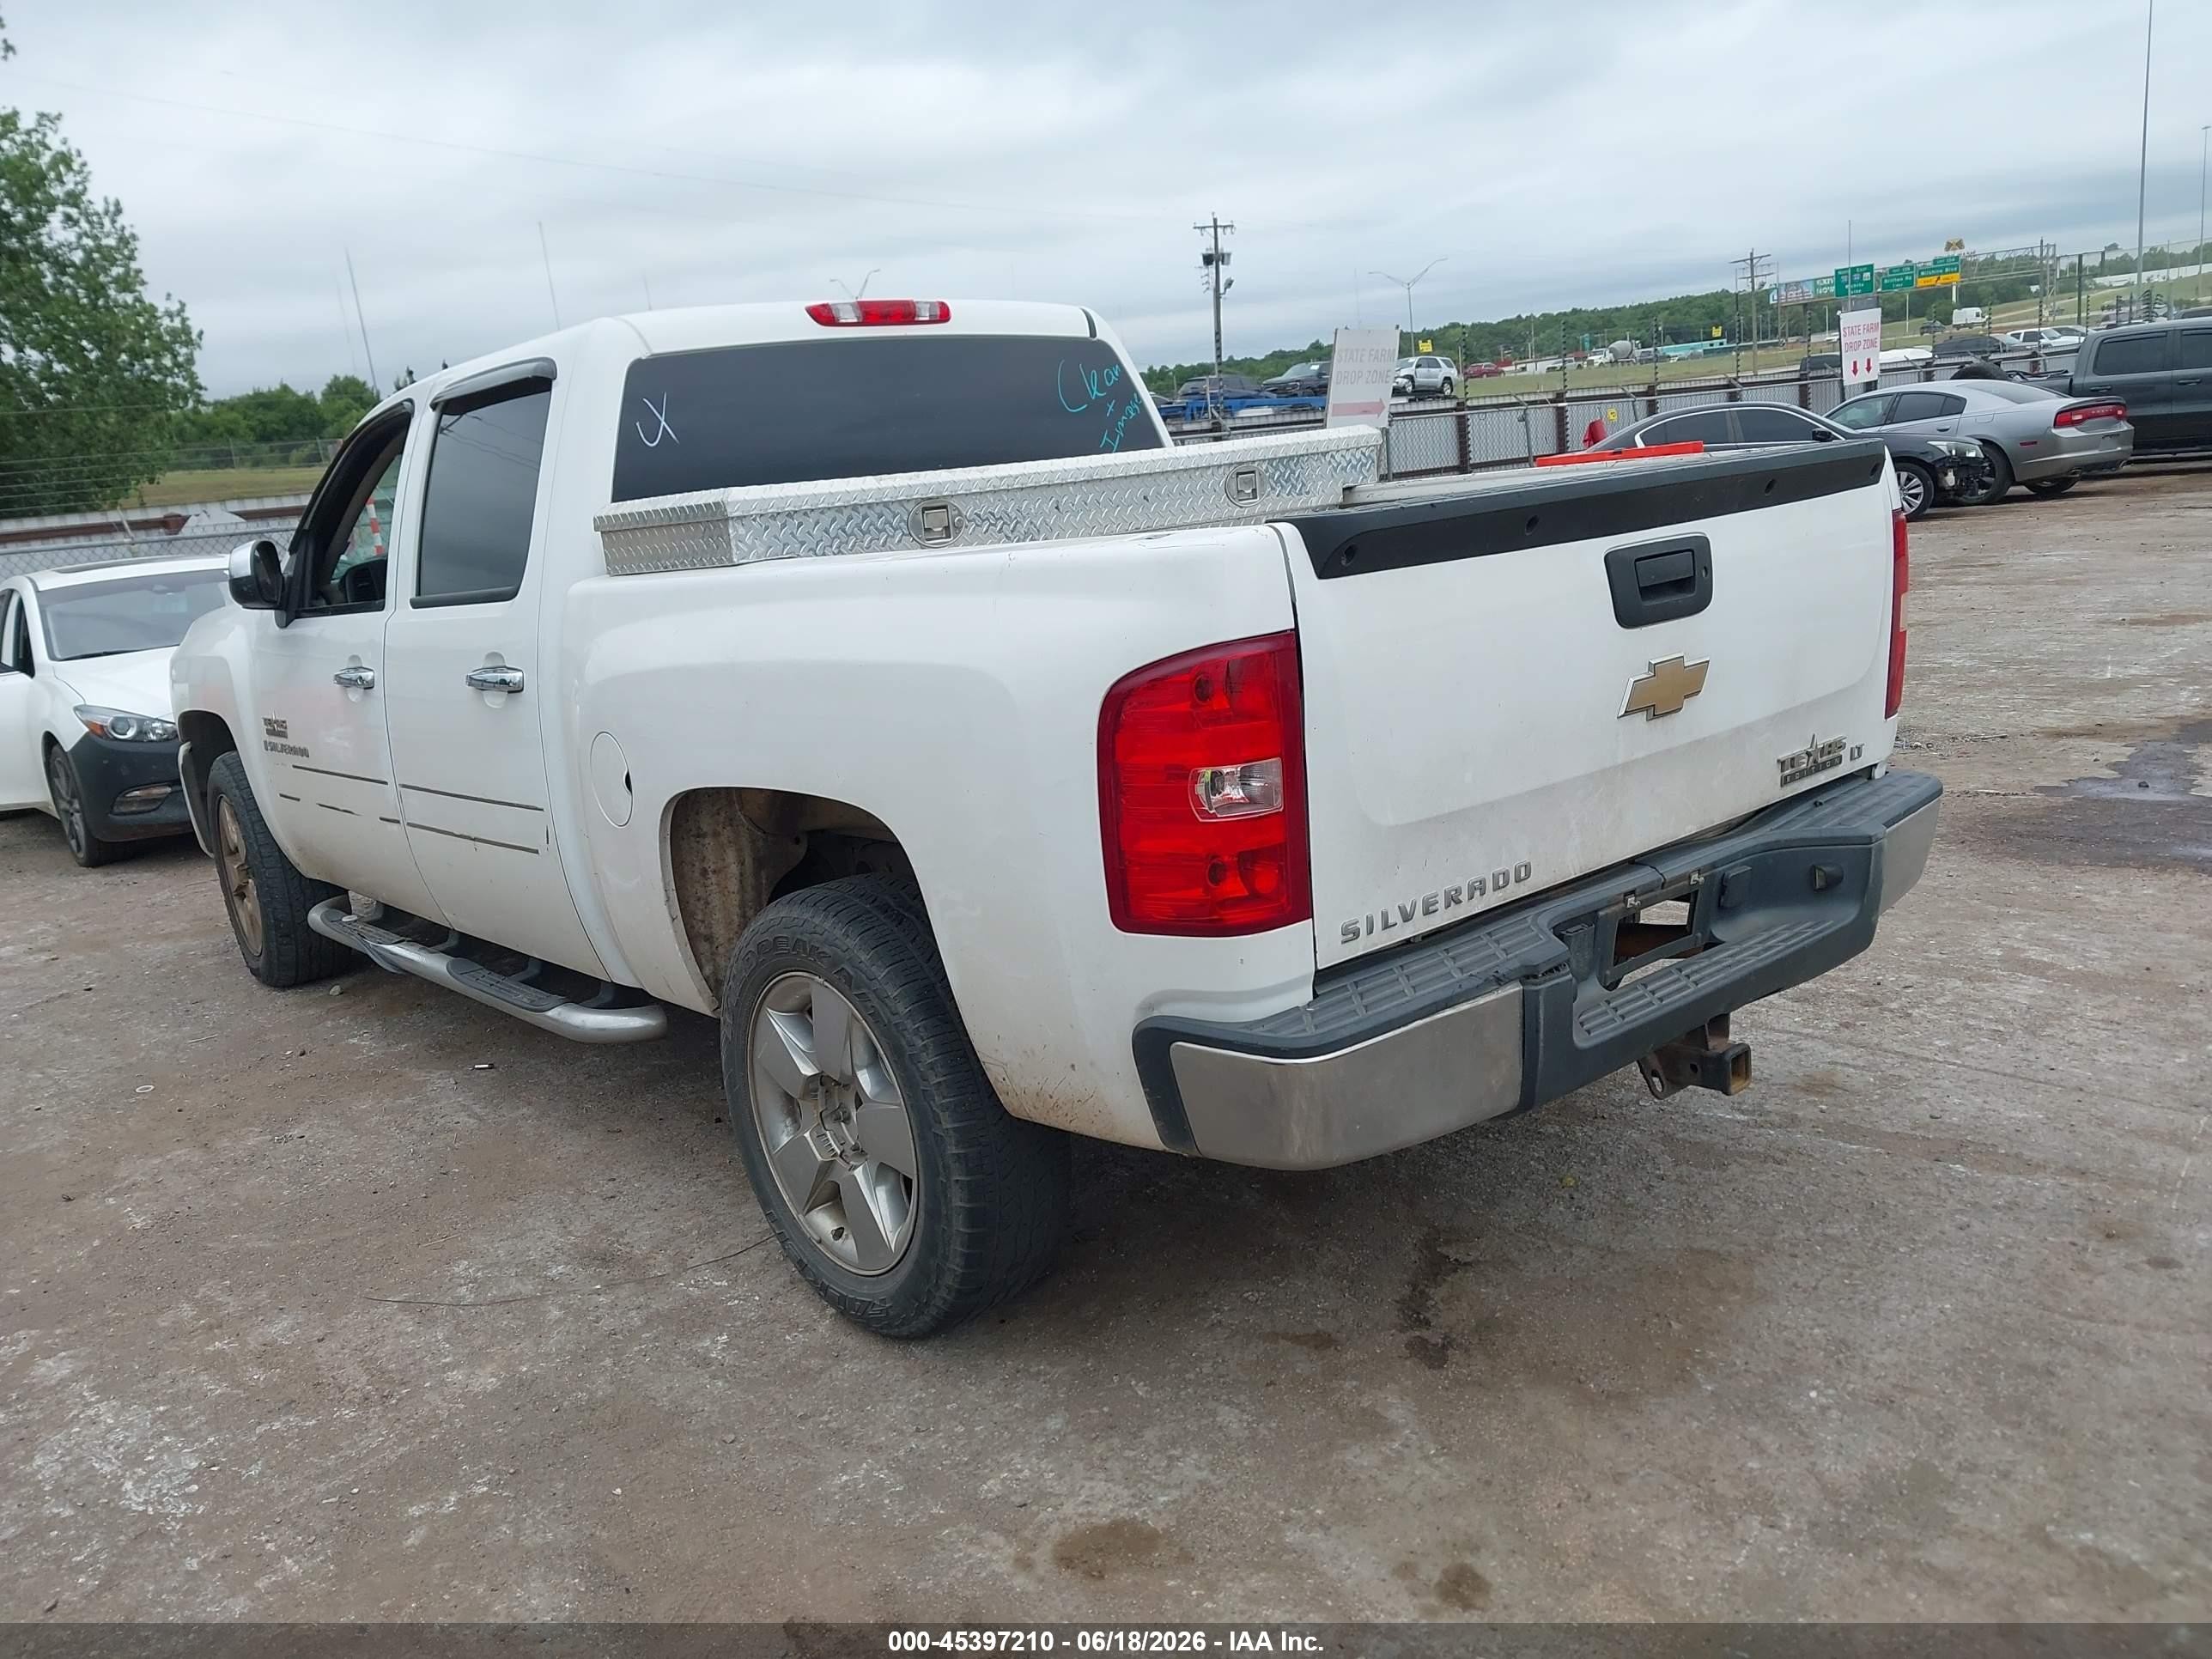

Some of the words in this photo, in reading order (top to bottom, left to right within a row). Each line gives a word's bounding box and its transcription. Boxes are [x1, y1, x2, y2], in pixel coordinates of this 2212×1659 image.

[1842, 323, 1862, 337] STATE
[1863, 321, 1880, 334] FARM
[1844, 340, 1862, 353] DROP
[1863, 337, 1879, 350] ZONE
[1336, 348, 1366, 363] STATE
[1369, 347, 1396, 362] FARM
[1335, 369, 1363, 386] DROP
[1364, 368, 1392, 385] ZONE
[1776, 734, 1848, 773] TEXAS
[1849, 743, 1865, 763] LT
[1784, 758, 1842, 783] EDITION
[1340, 859, 1533, 945] SILVERADO
